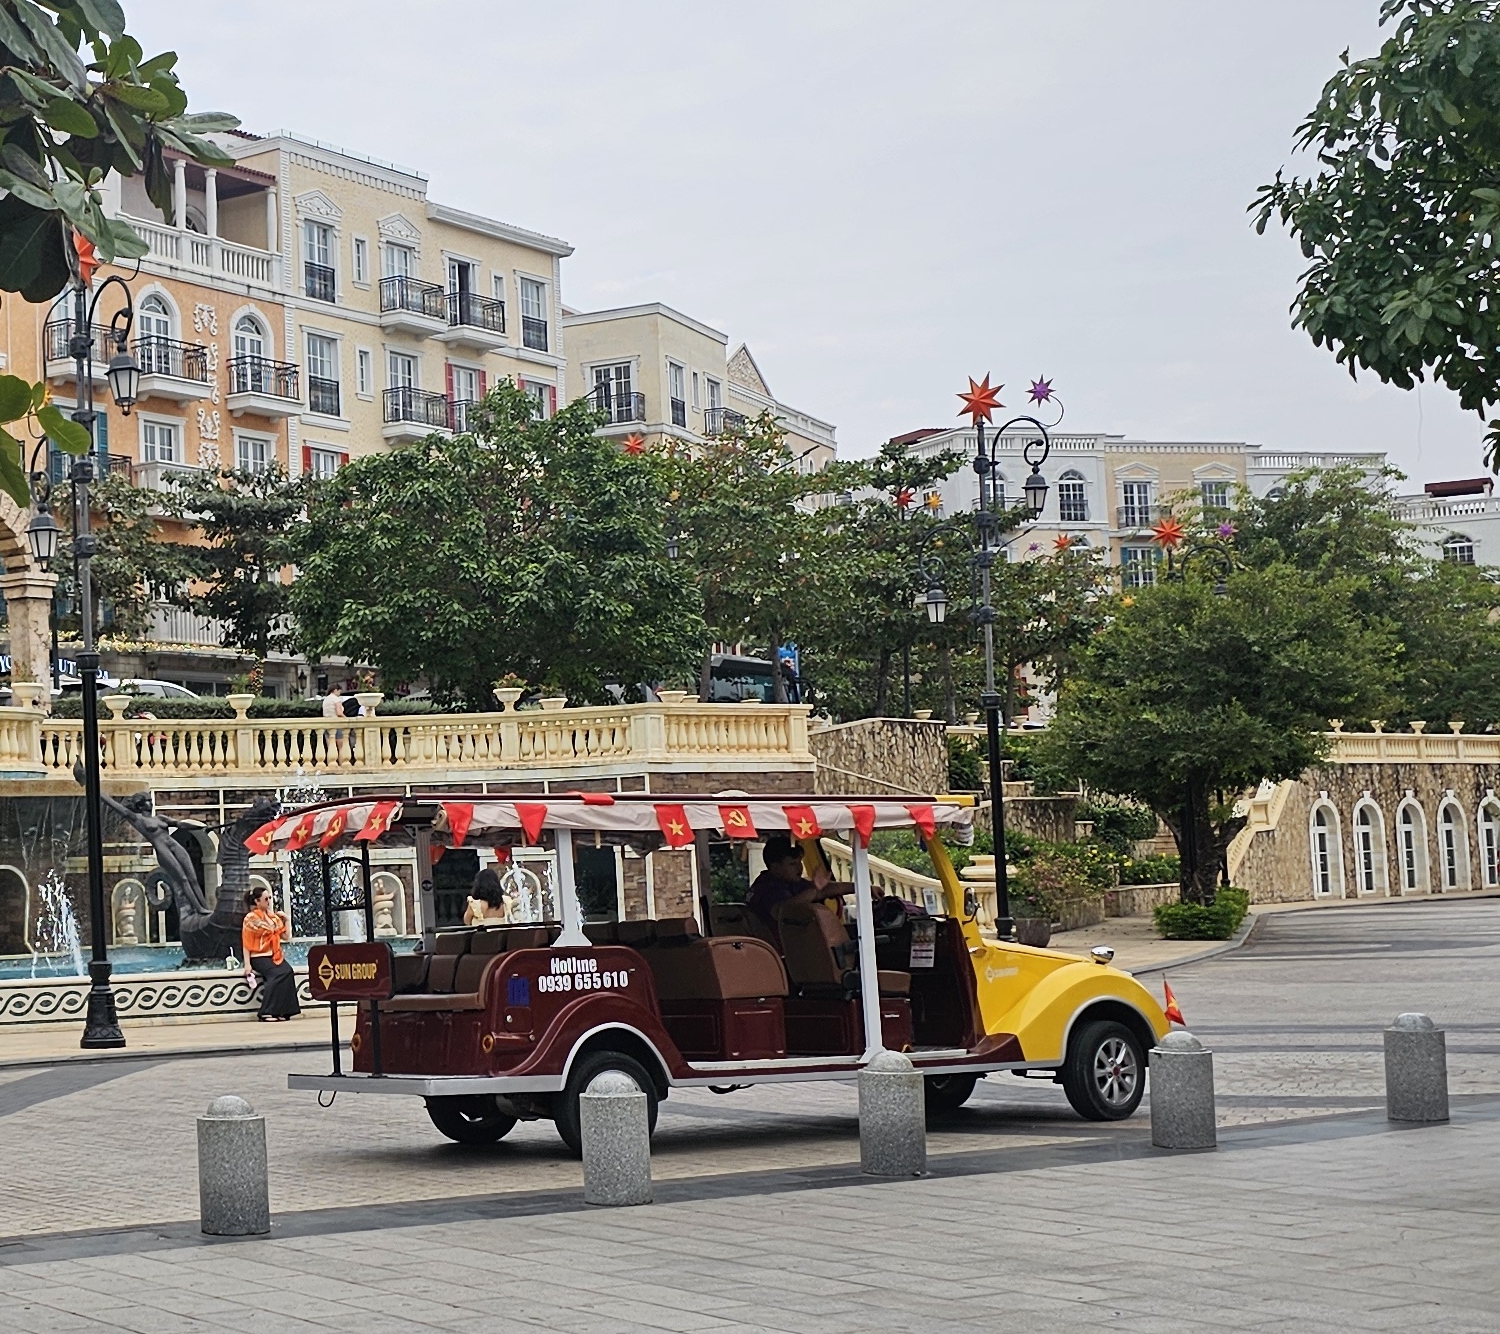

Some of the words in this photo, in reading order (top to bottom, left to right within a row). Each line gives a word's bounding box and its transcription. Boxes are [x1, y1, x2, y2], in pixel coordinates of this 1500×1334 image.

[334, 963, 352, 980] SUN
[351, 962, 377, 980] GROUP
[550, 957, 598, 974] Hotline
[538, 975, 572, 993] 0939
[574, 972, 602, 990] 655
[602, 970, 629, 988] 610
